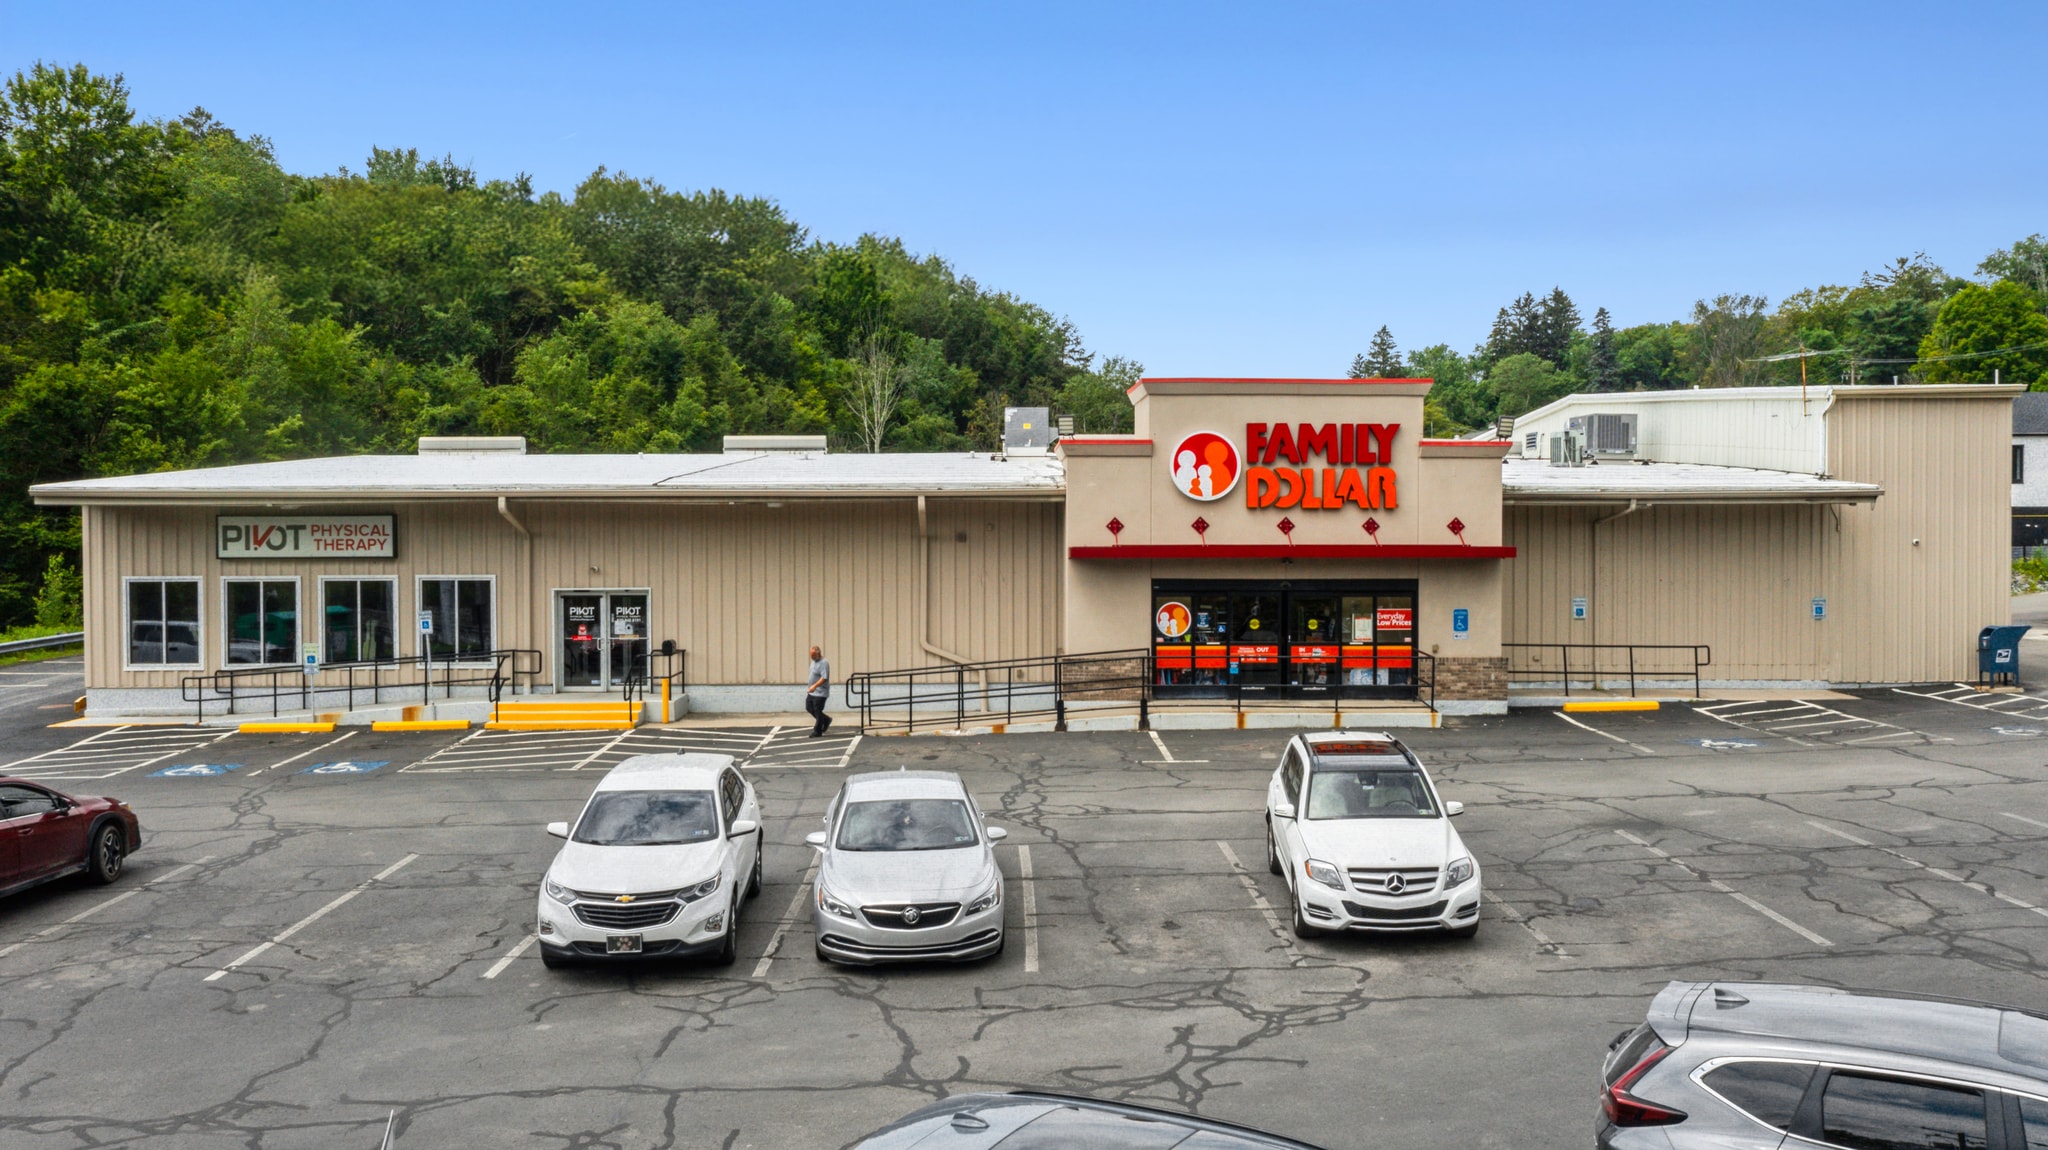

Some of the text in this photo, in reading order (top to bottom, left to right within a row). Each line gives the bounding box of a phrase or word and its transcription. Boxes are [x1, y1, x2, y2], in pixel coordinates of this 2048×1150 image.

[1246, 423, 1400, 464] FAMILY
[1246, 467, 1398, 509] DOLLAR
[310, 524, 390, 537] PHYSICAL
[222, 525, 306, 550] PIVOT
[314, 538, 388, 551] THERAPY
[570, 606, 595, 615] PIVOT
[616, 606, 641, 615] PIVOT
[1377, 612, 1405, 621] Everyday
